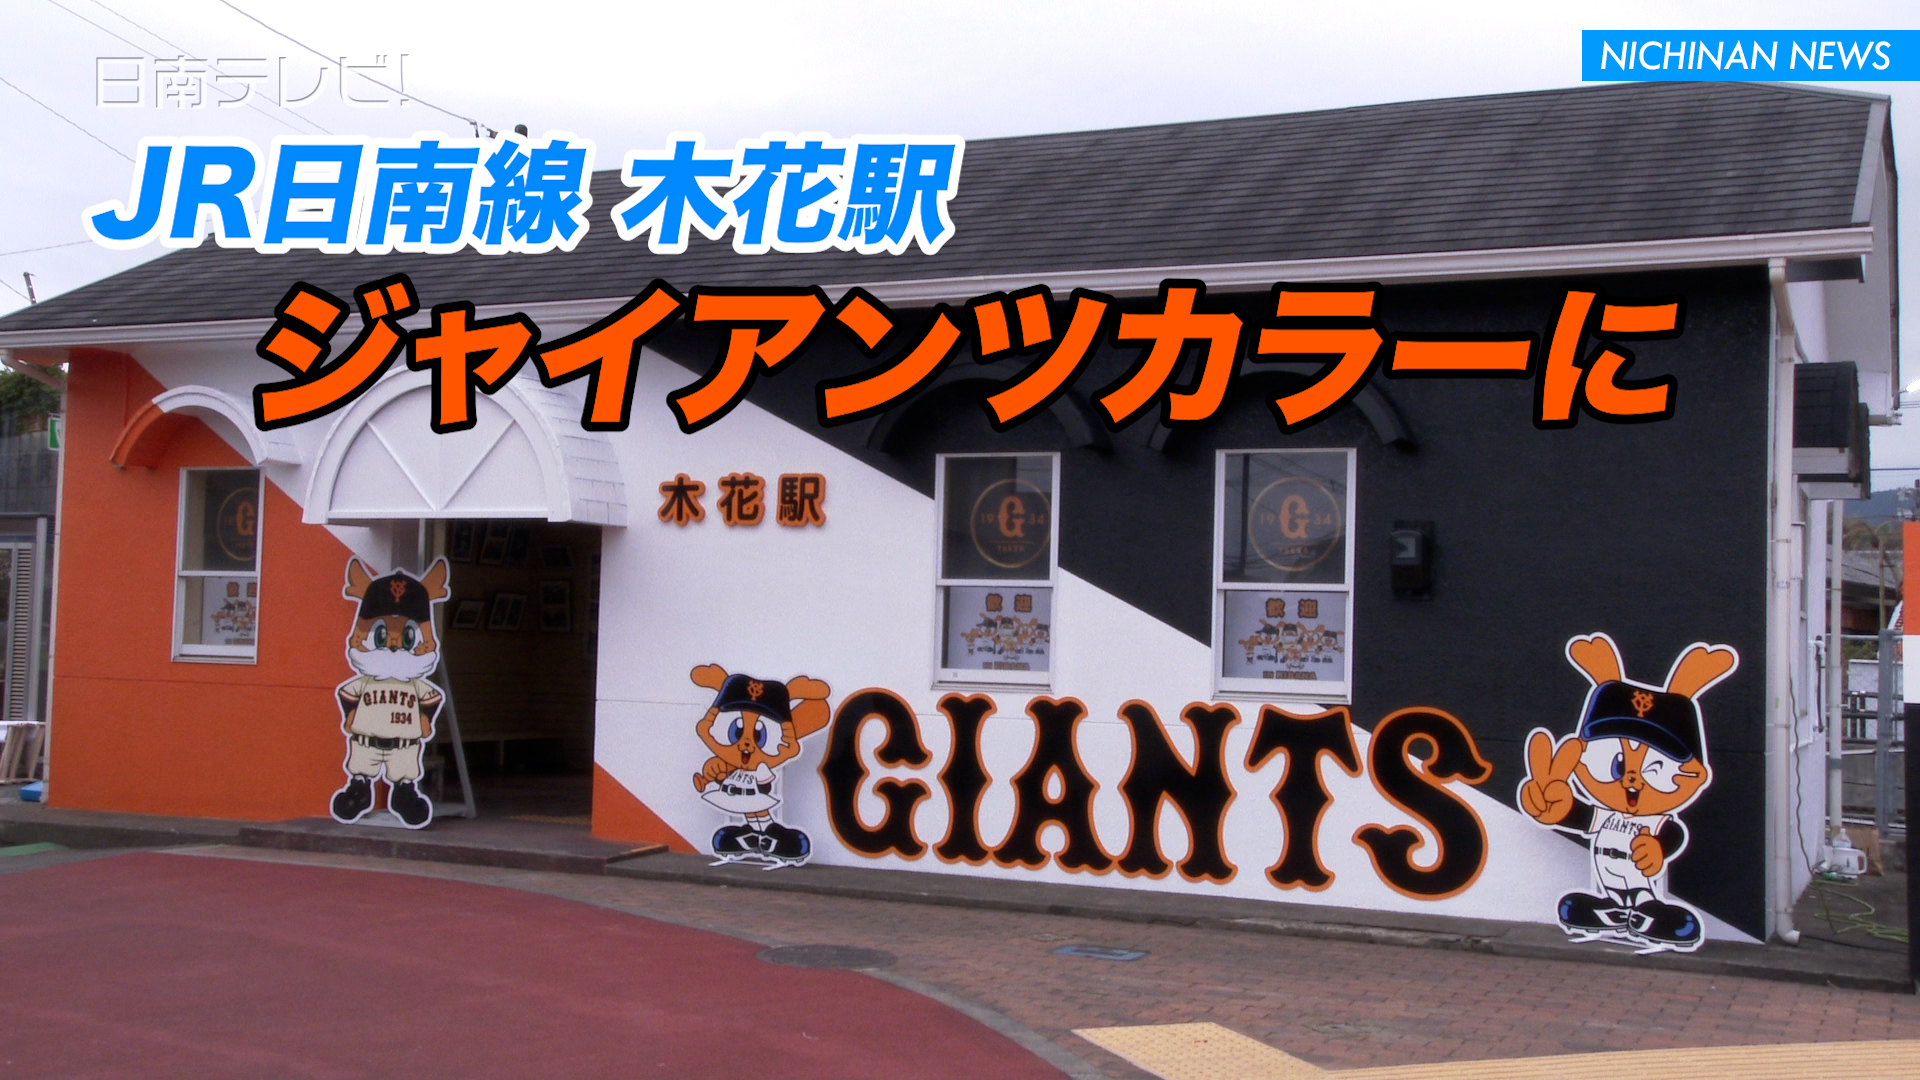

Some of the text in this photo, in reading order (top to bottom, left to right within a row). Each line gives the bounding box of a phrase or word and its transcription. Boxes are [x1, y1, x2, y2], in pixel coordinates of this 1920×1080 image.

[658, 472, 827, 528] 木花駅
[998, 495, 1025, 538] G
[1278, 494, 1310, 539] G
[363, 690, 416, 709] GIANTS
[390, 712, 412, 725] 1934
[819, 687, 1492, 901] GIANTS
[1603, 818, 1643, 837] GIANTS
